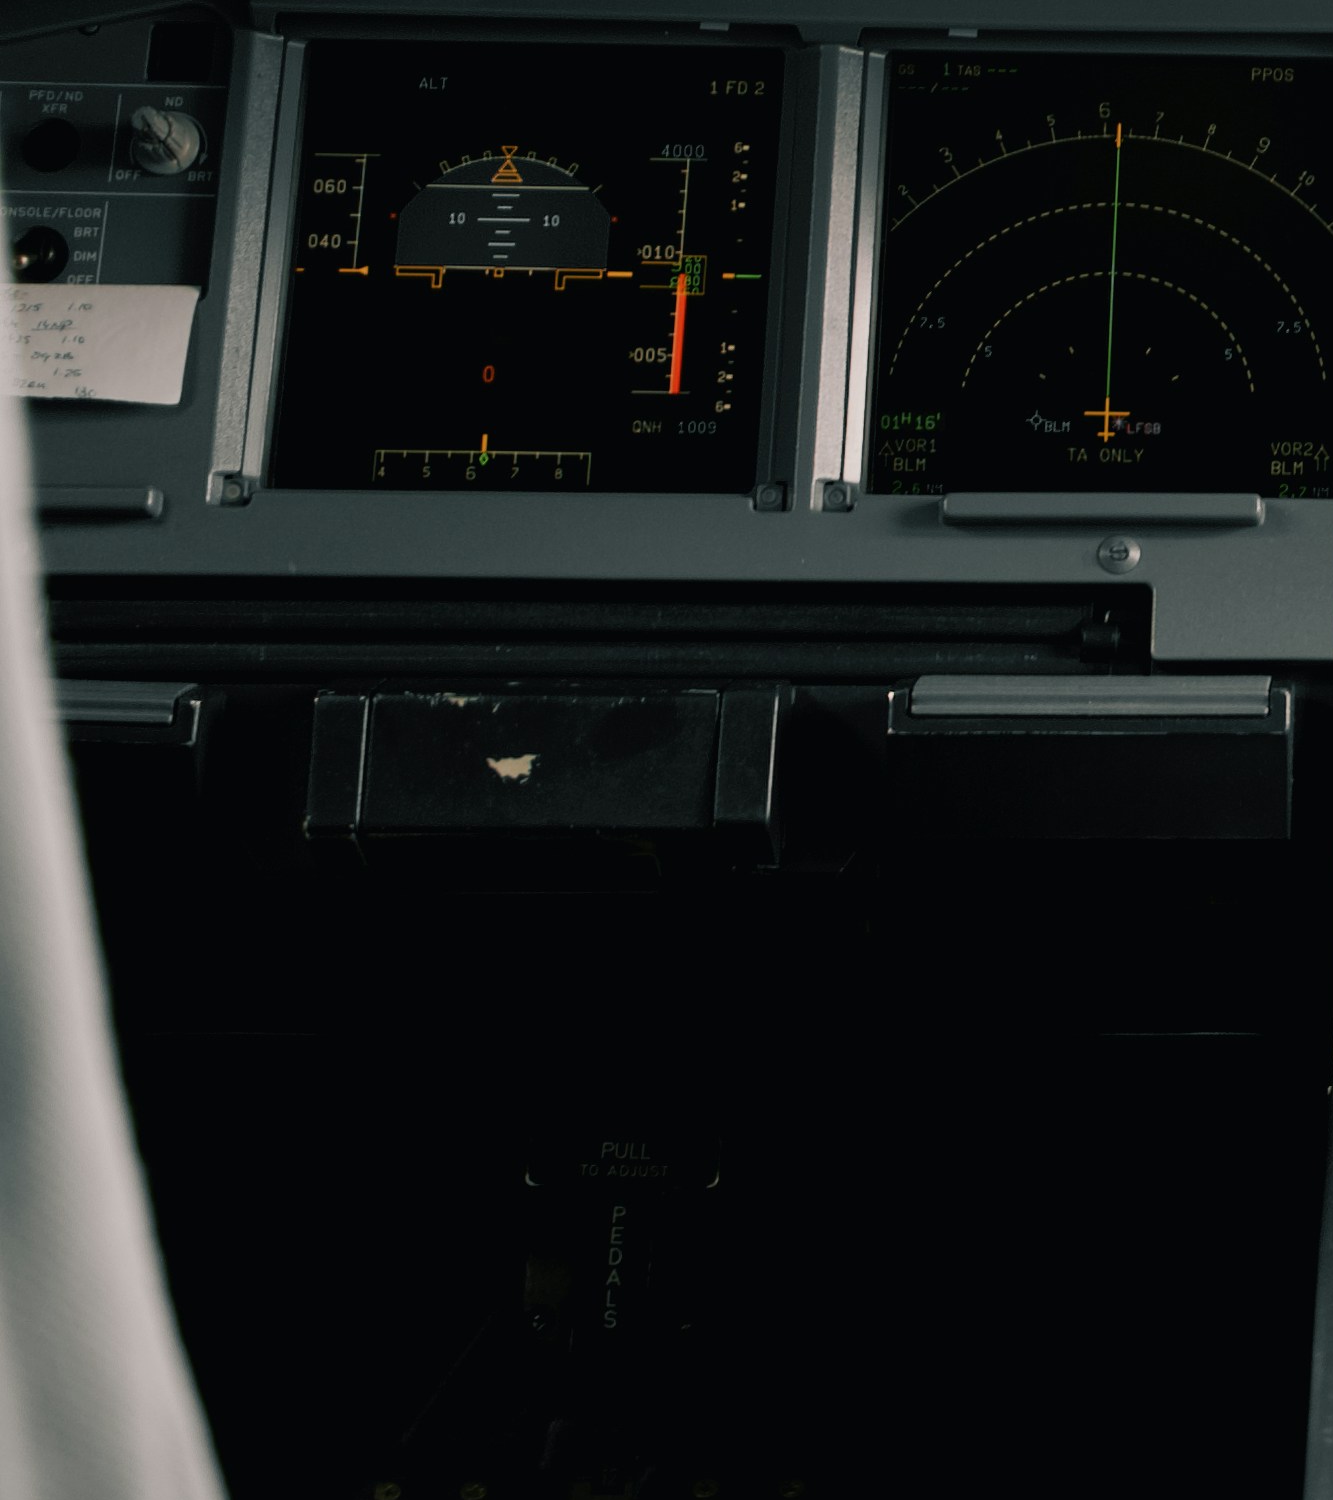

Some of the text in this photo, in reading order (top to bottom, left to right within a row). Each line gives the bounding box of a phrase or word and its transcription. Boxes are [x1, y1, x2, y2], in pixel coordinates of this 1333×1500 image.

[1250, 67, 1294, 82] PPOS
[418, 77, 448, 90] ALT
[29, 90, 84, 101] PFD/ND
[165, 97, 183, 107] ND
[42, 104, 68, 114] XFR
[116, 170, 140, 180] OFF
[74, 227, 99, 237] BRT
[73, 251, 96, 261] DIM
[894, 439, 937, 454] VOR1
[1271, 442, 1313, 457] VOR2
[1067, 448, 1143, 462] TA ONLY
[893, 458, 926, 472] BLM
[1271, 460, 1304, 475] BLM
[600, 1141, 651, 1160] PULL
